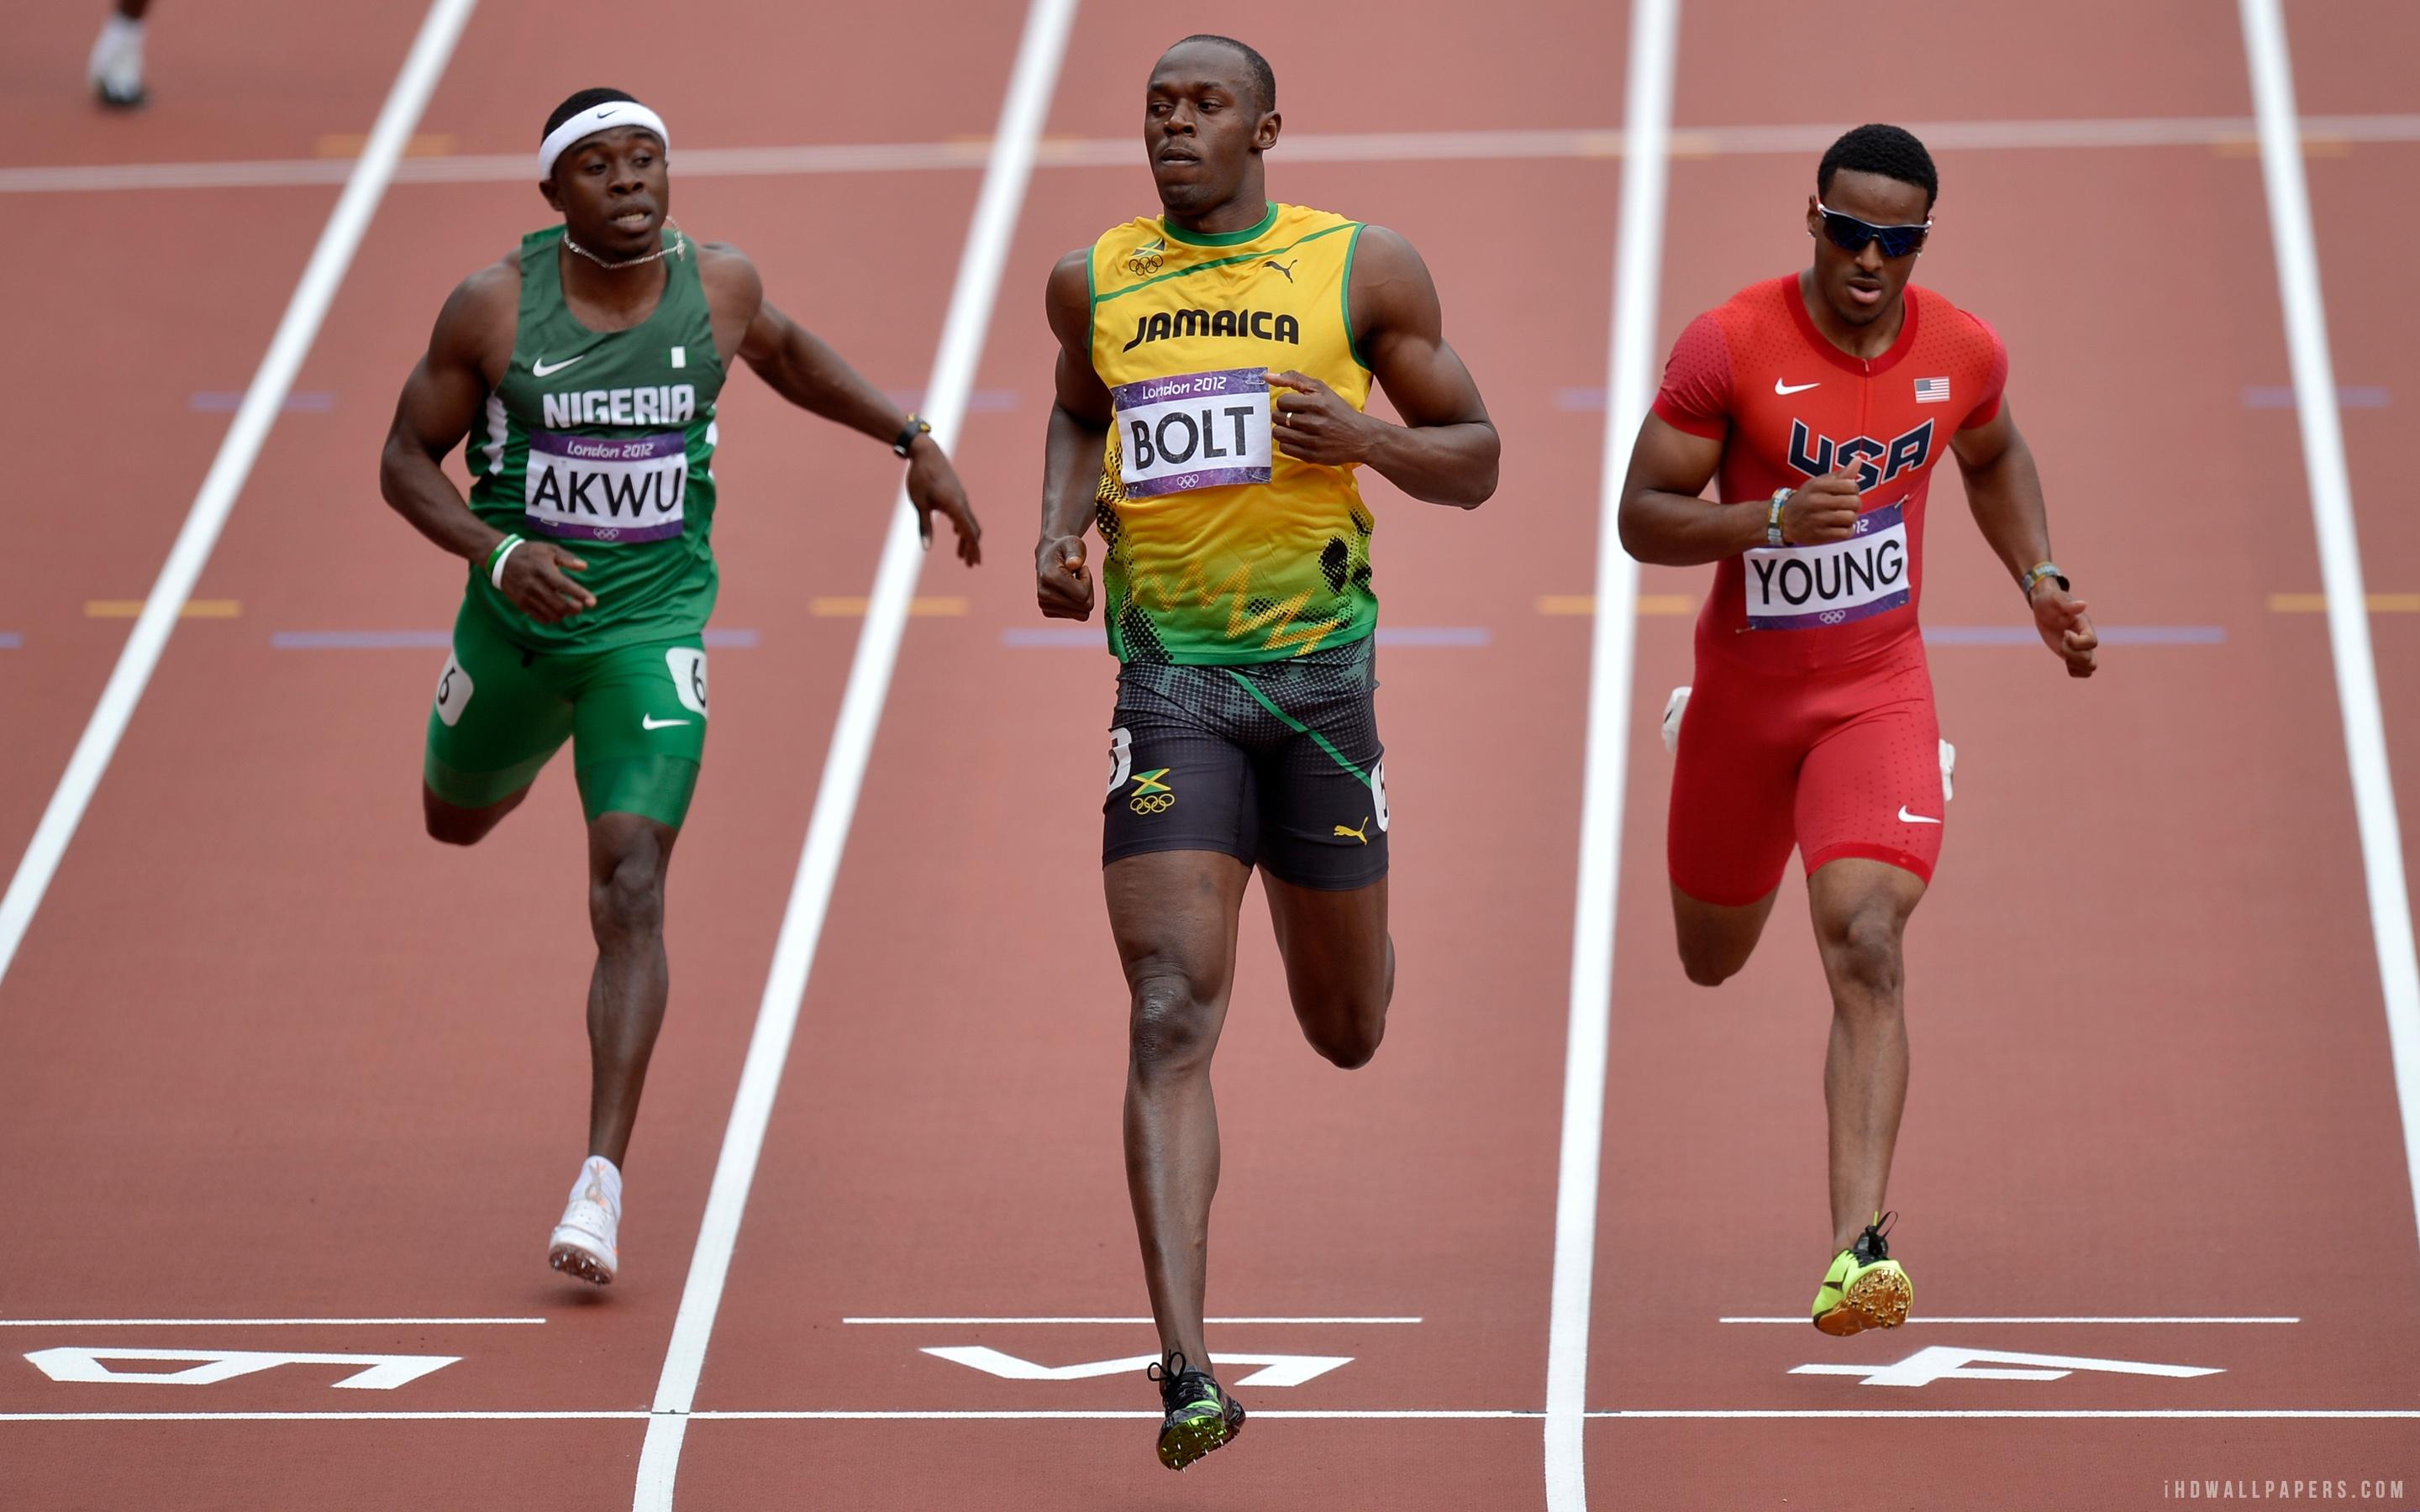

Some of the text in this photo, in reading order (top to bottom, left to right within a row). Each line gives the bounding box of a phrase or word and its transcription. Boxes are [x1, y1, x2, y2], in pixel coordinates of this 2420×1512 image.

[1123, 309, 1299, 353] JAMAICA
[543, 384, 695, 428] NIGERIA
[1142, 376, 1227, 400] London 2012
[567, 440, 655, 459] London 2012
[1130, 406, 1255, 470] BOLT
[1787, 417, 1934, 496] USA
[531, 465, 682, 517] AKWU
[1750, 539, 1903, 606] YOUNG
[690, 658, 708, 708] 6
[22, 1346, 465, 1390] 6
[918, 1345, 1355, 1388] 5
[1786, 1346, 2228, 1388] 4
